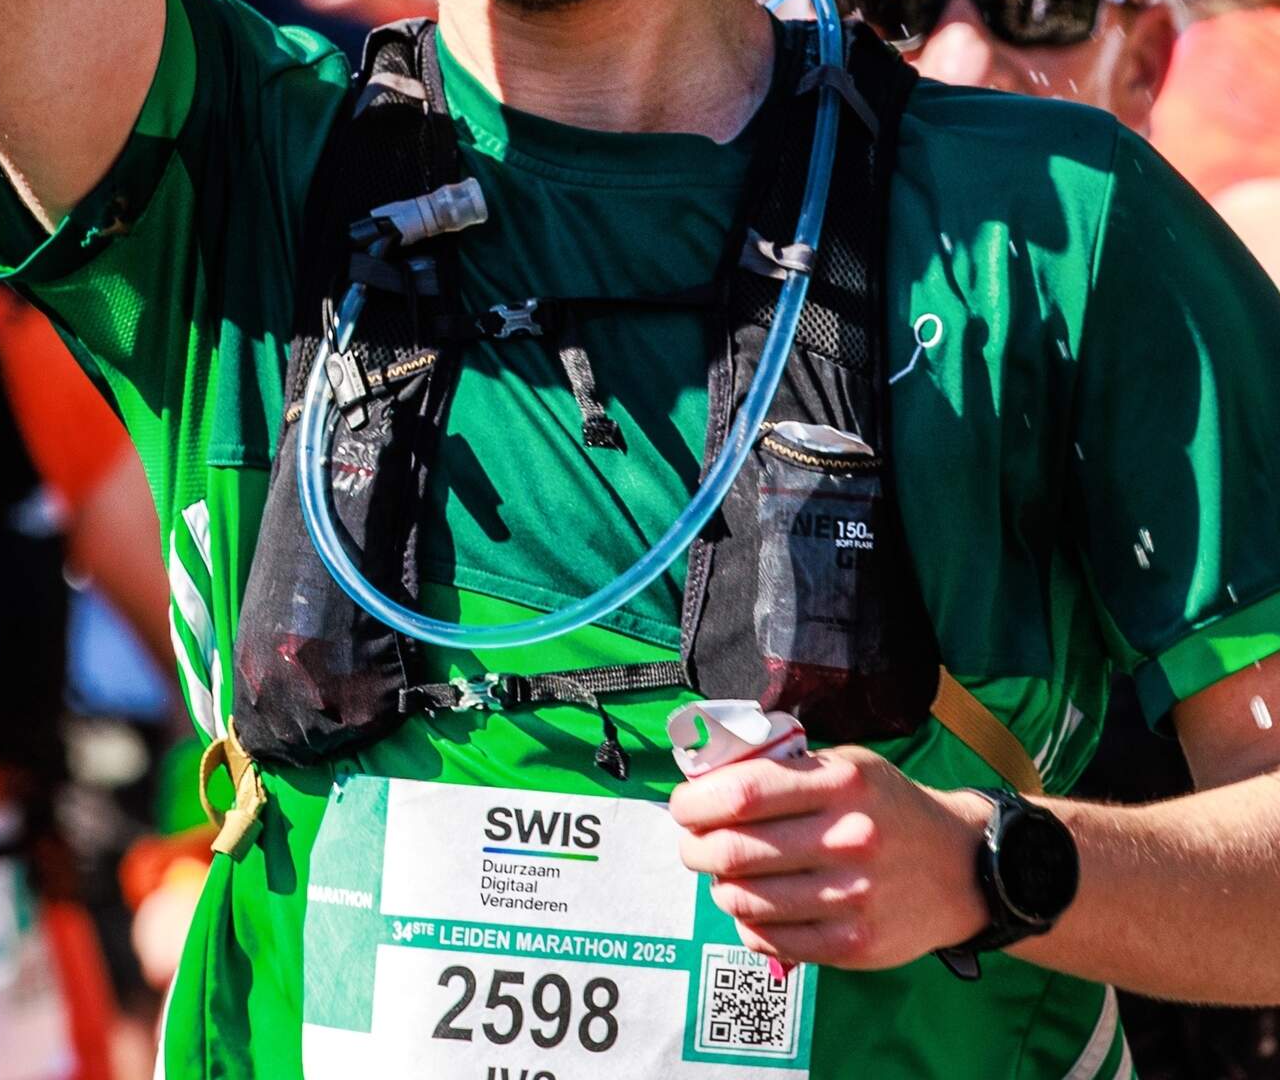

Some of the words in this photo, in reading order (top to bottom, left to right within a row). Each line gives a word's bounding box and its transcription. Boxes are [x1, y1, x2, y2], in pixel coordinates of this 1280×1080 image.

[483, 806, 601, 849] SWIS
[482, 859, 561, 879] Duurzaam
[480, 876, 538, 894] Digitaal
[479, 893, 568, 913] Veranderen
[439, 925, 510, 950] LEIDEN
[518, 933, 628, 960] MARATHON
[632, 941, 677, 964] 2025
[727, 949, 768, 966] UITSL
[431, 964, 620, 1053] 2598
